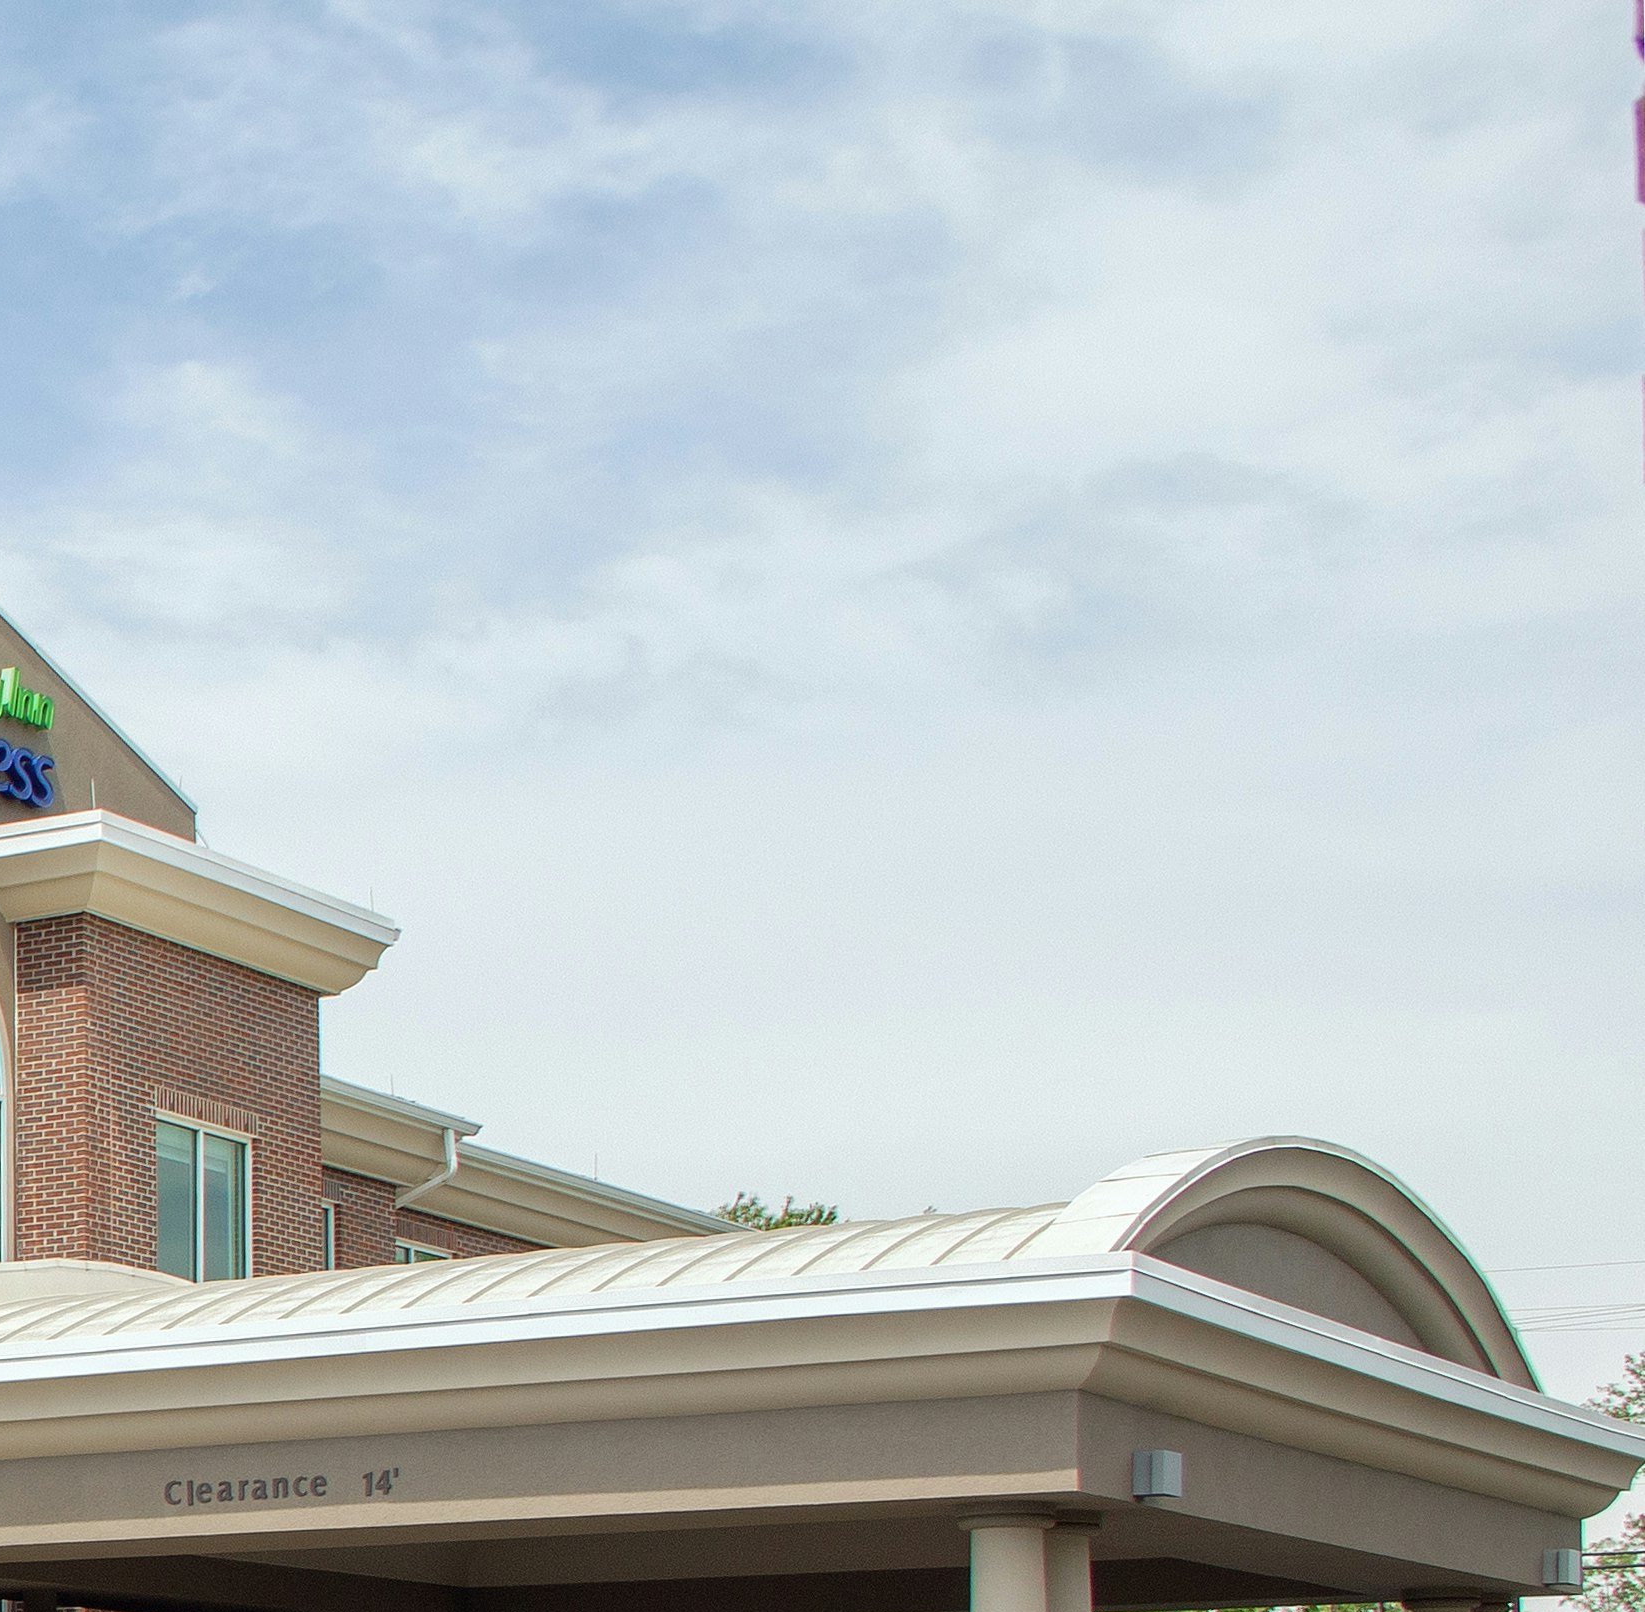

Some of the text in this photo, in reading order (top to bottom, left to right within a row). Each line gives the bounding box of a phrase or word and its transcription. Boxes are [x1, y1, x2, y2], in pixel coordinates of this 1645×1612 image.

[0, 667, 55, 731] Inn
[163, 1467, 400, 1506] Clearance 14'
